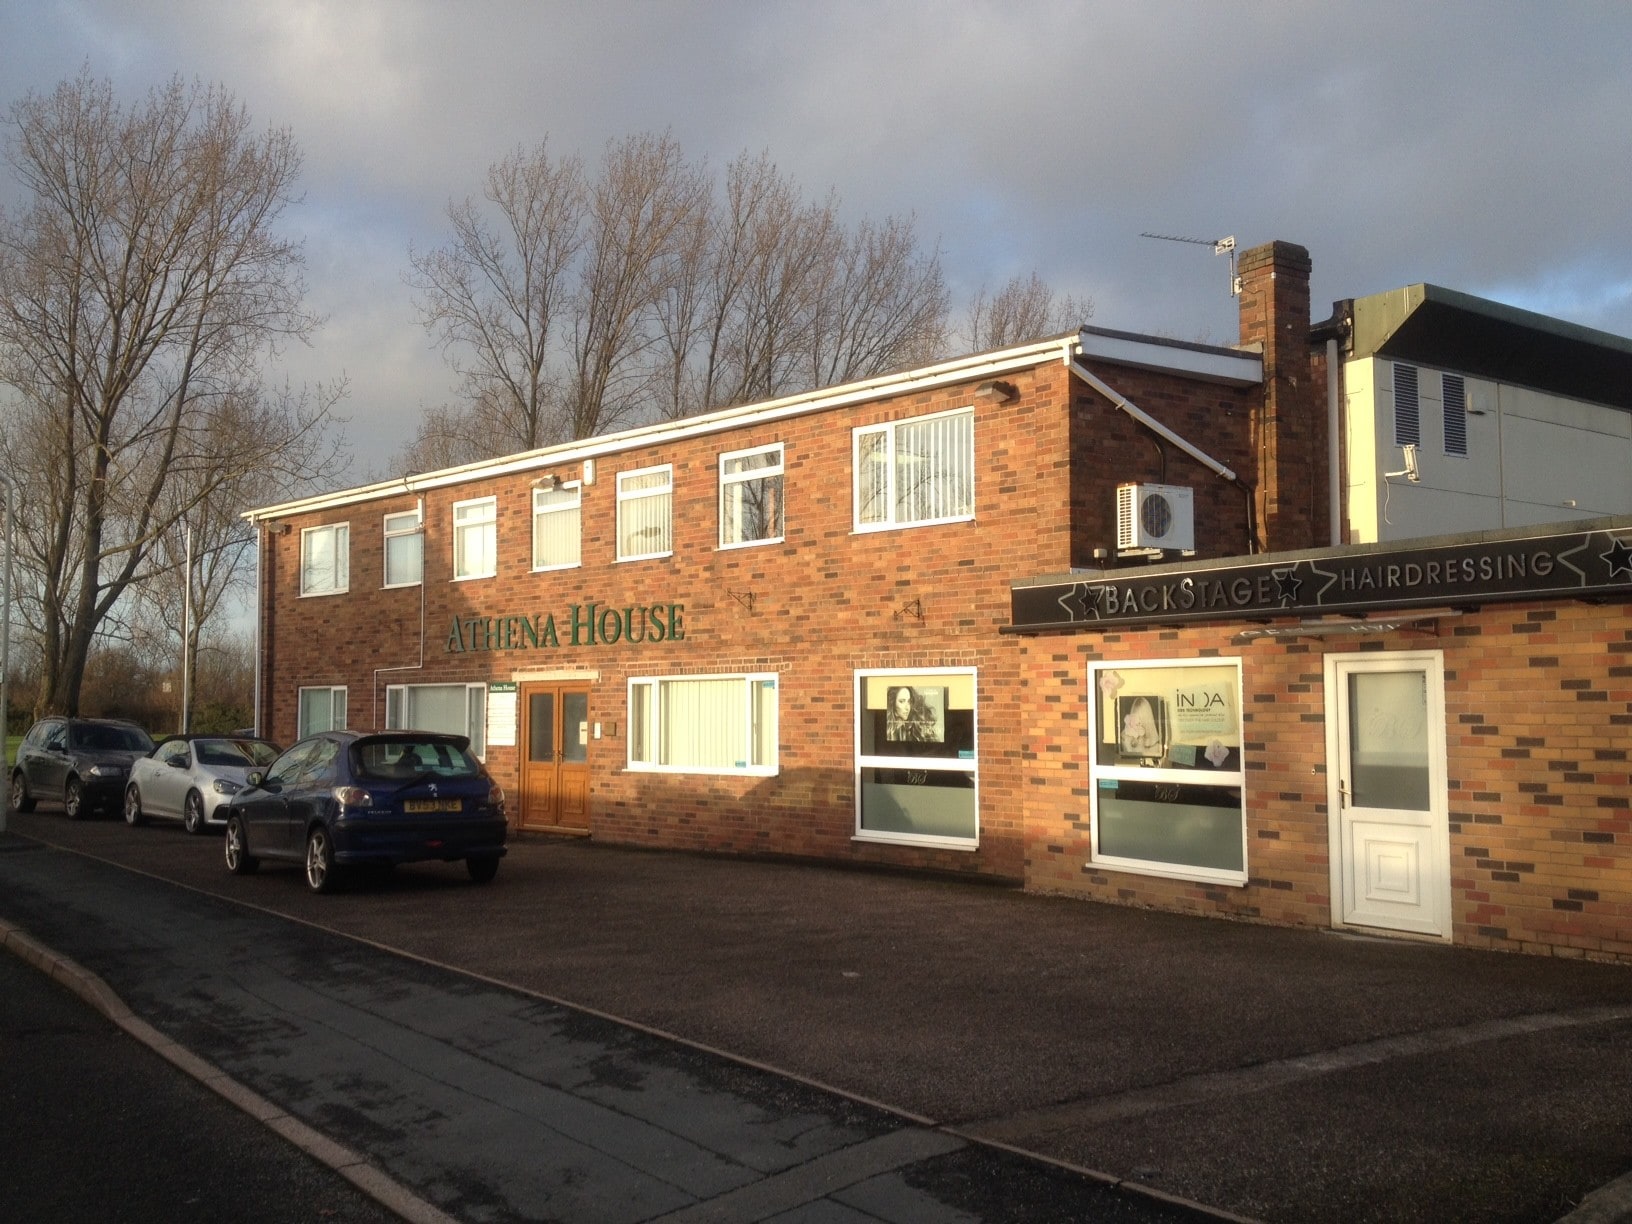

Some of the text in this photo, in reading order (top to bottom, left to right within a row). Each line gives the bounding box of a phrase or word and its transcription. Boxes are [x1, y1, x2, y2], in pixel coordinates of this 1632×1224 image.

[1341, 551, 1554, 591] HAIRDRESSING
[446, 602, 686, 653] ATHENA HOUSE
